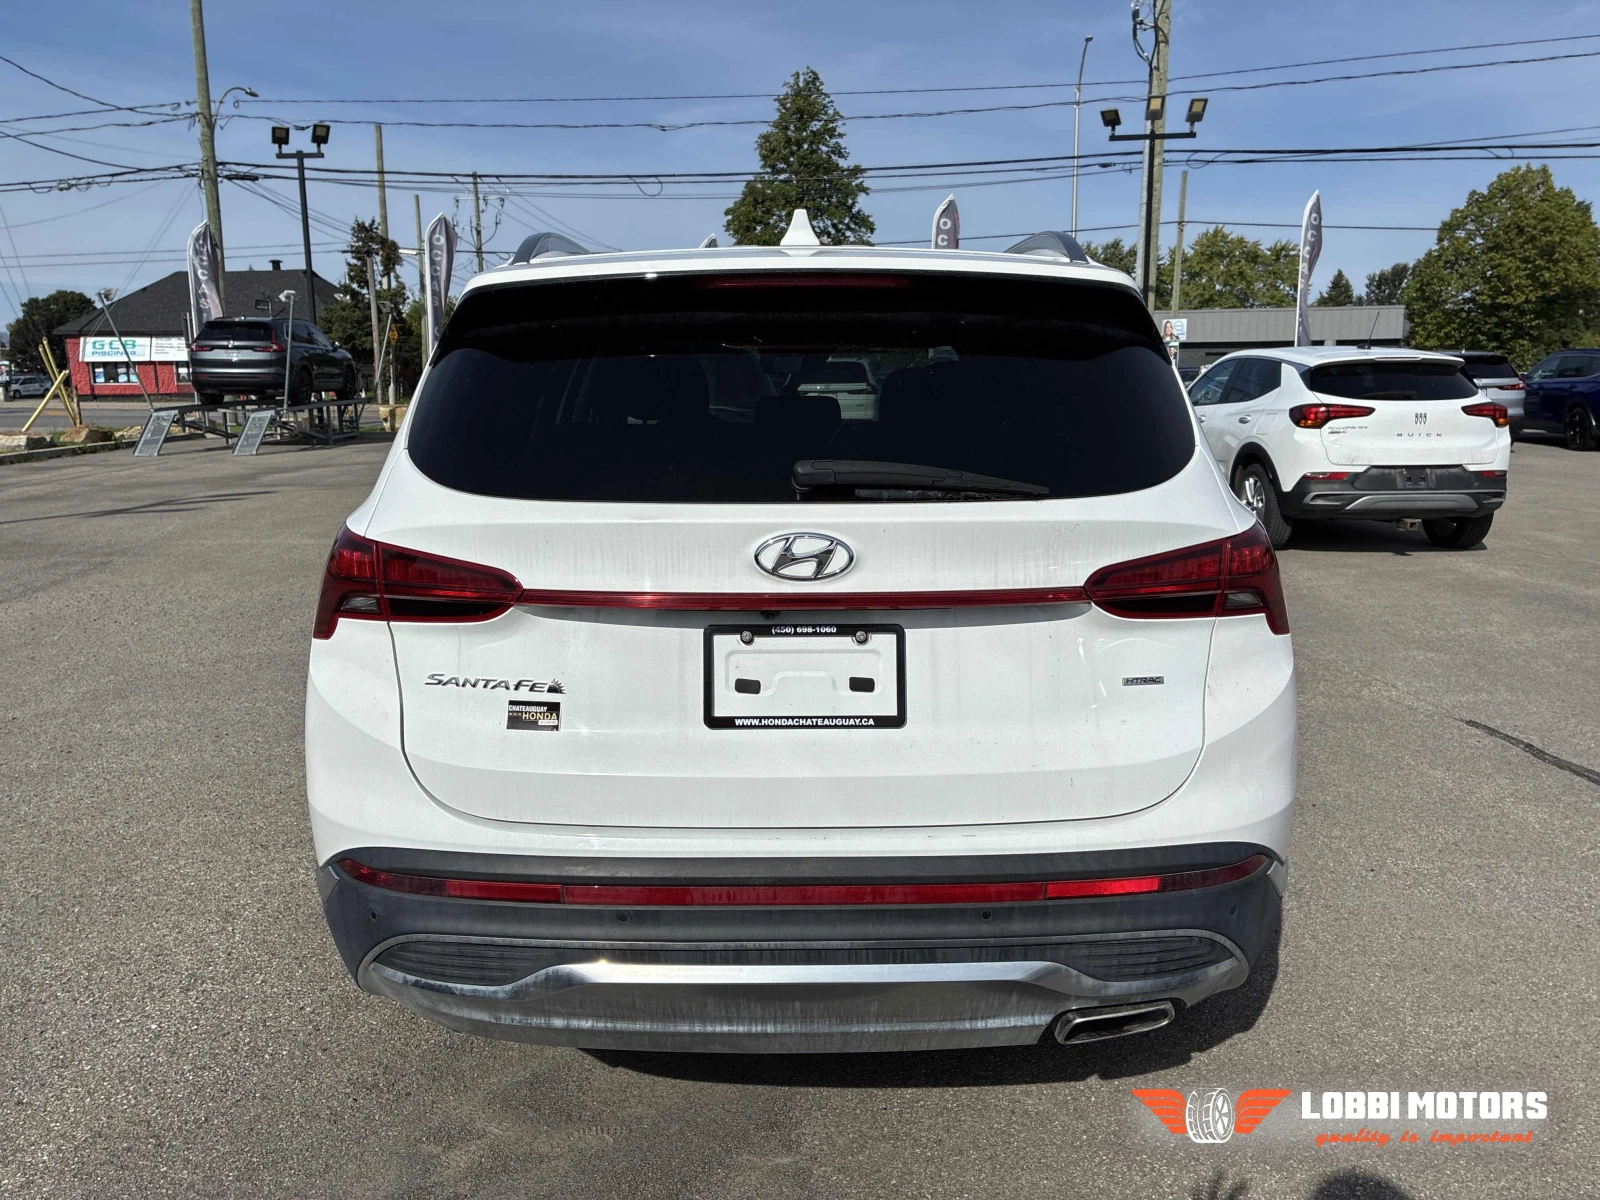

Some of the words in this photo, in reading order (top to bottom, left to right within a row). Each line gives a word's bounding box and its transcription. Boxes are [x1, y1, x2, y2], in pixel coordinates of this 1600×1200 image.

[92, 339, 137, 350] GCB
[771, 626, 795, 635] (450)
[796, 626, 837, 634] 698-1060
[1125, 676, 1162, 685] HTRAC
[508, 704, 548, 713] CHATEAUGUAY
[522, 712, 558, 720] HONDA
[735, 718, 875, 726] WWW.HONDACHATEAUGUAY.CA
